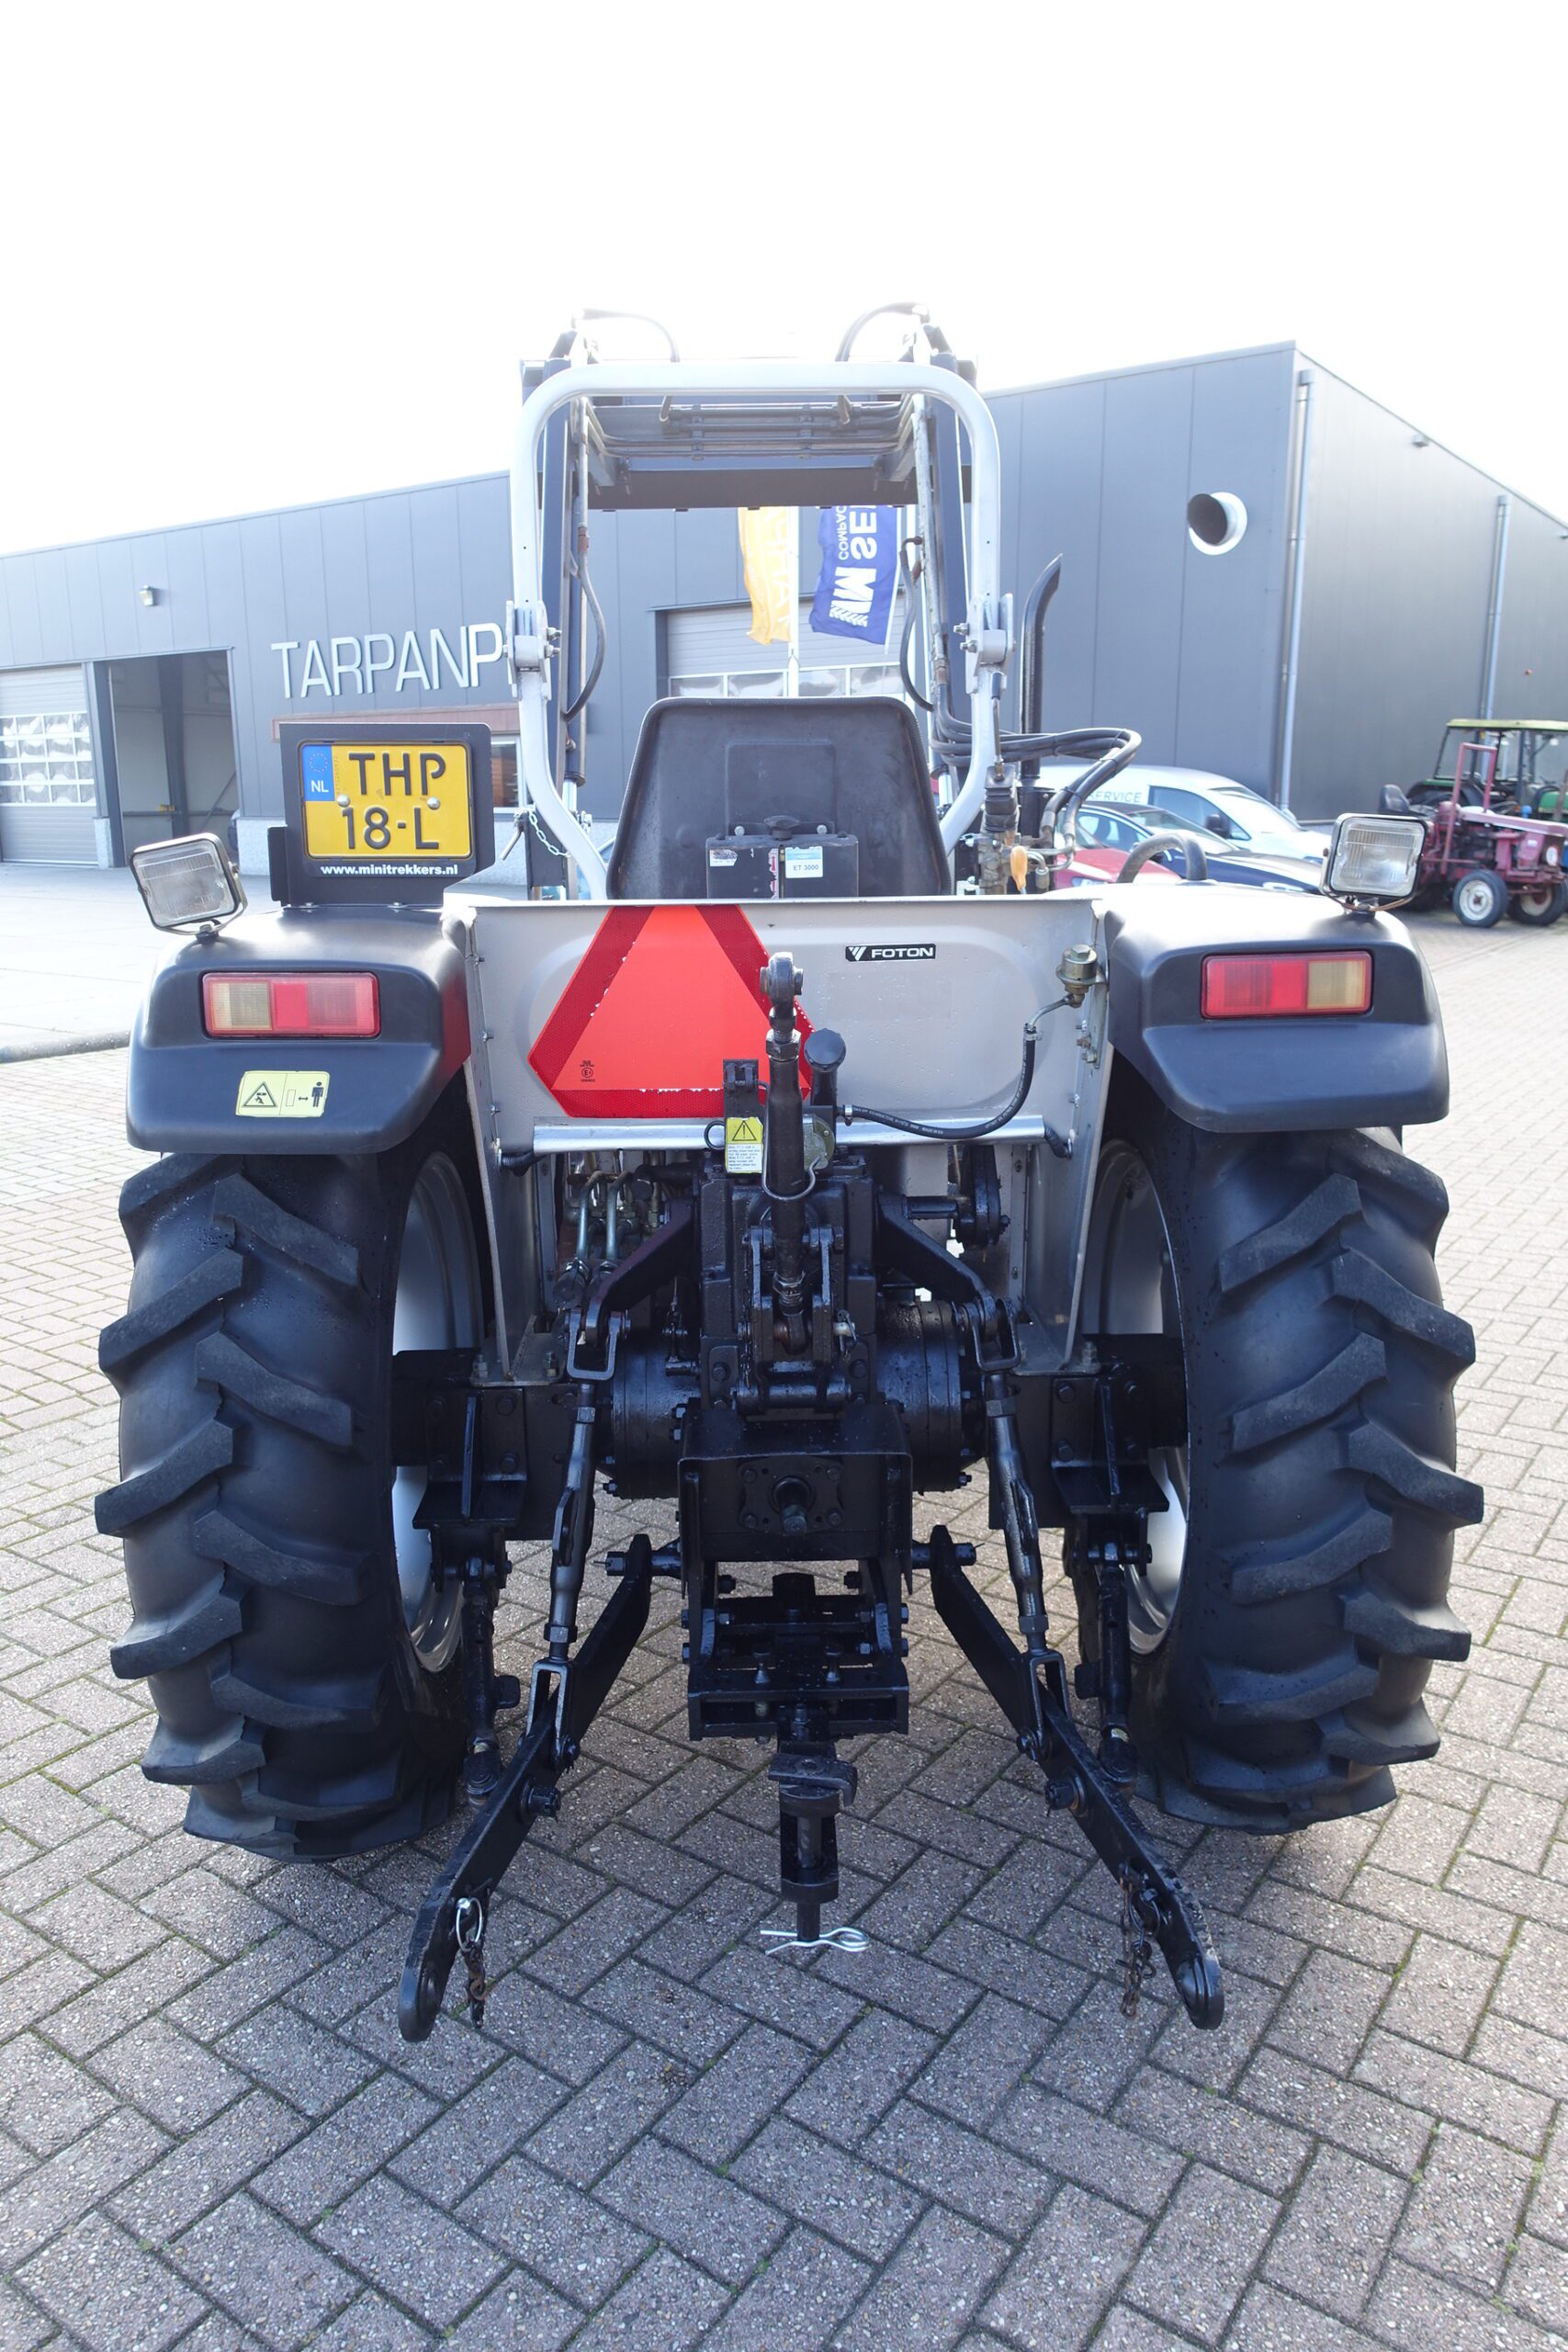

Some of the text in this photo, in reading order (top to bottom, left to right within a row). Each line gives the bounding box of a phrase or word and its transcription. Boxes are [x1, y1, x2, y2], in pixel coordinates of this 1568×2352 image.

[271, 622, 513, 698] TARPANP
[310, 780, 329, 793] NL
[349, 752, 446, 796] THP
[342, 807, 440, 850] 18-L
[321, 864, 458, 876] www.minitrekkers.nl
[872, 947, 933, 958] FOTON
